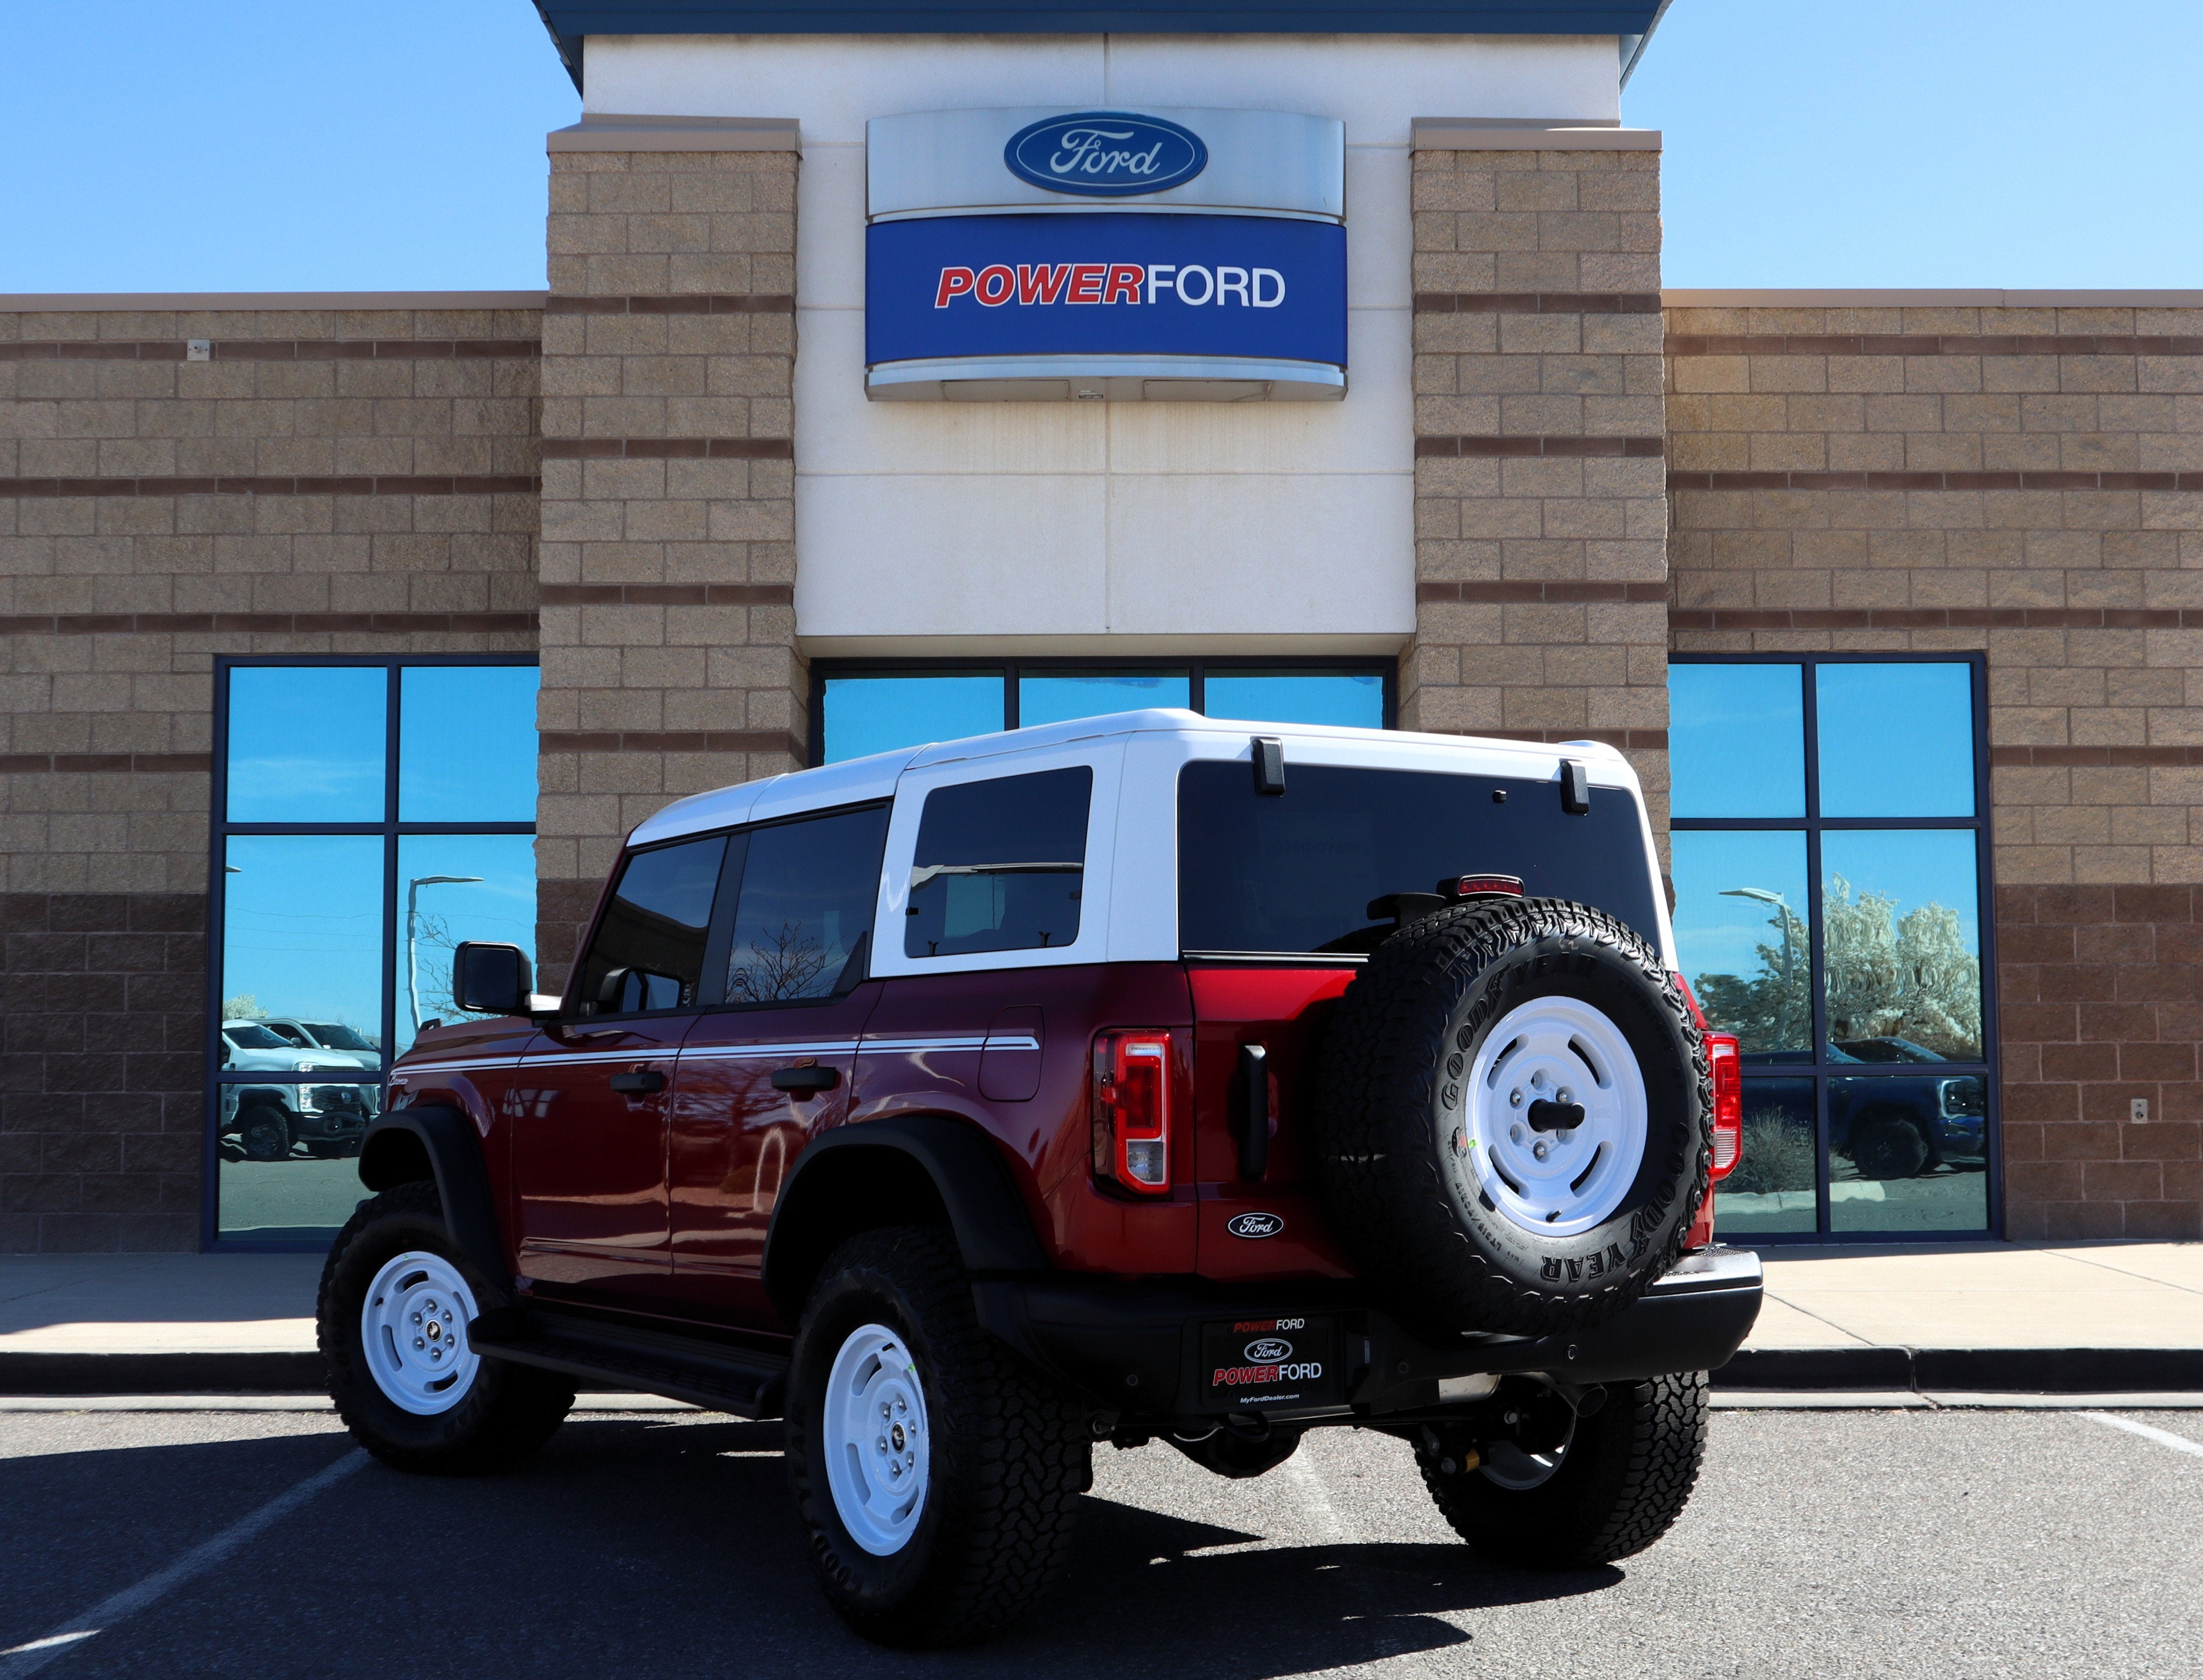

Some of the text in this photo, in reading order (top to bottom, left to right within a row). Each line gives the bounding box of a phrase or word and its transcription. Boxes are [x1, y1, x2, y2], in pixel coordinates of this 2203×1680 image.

[1050, 129, 1162, 175] Ford
[1239, 1216, 1274, 1233] Ford
[1254, 1343, 1283, 1358] Ford
[1240, 1394, 1299, 1404] MyFordDealer.com
